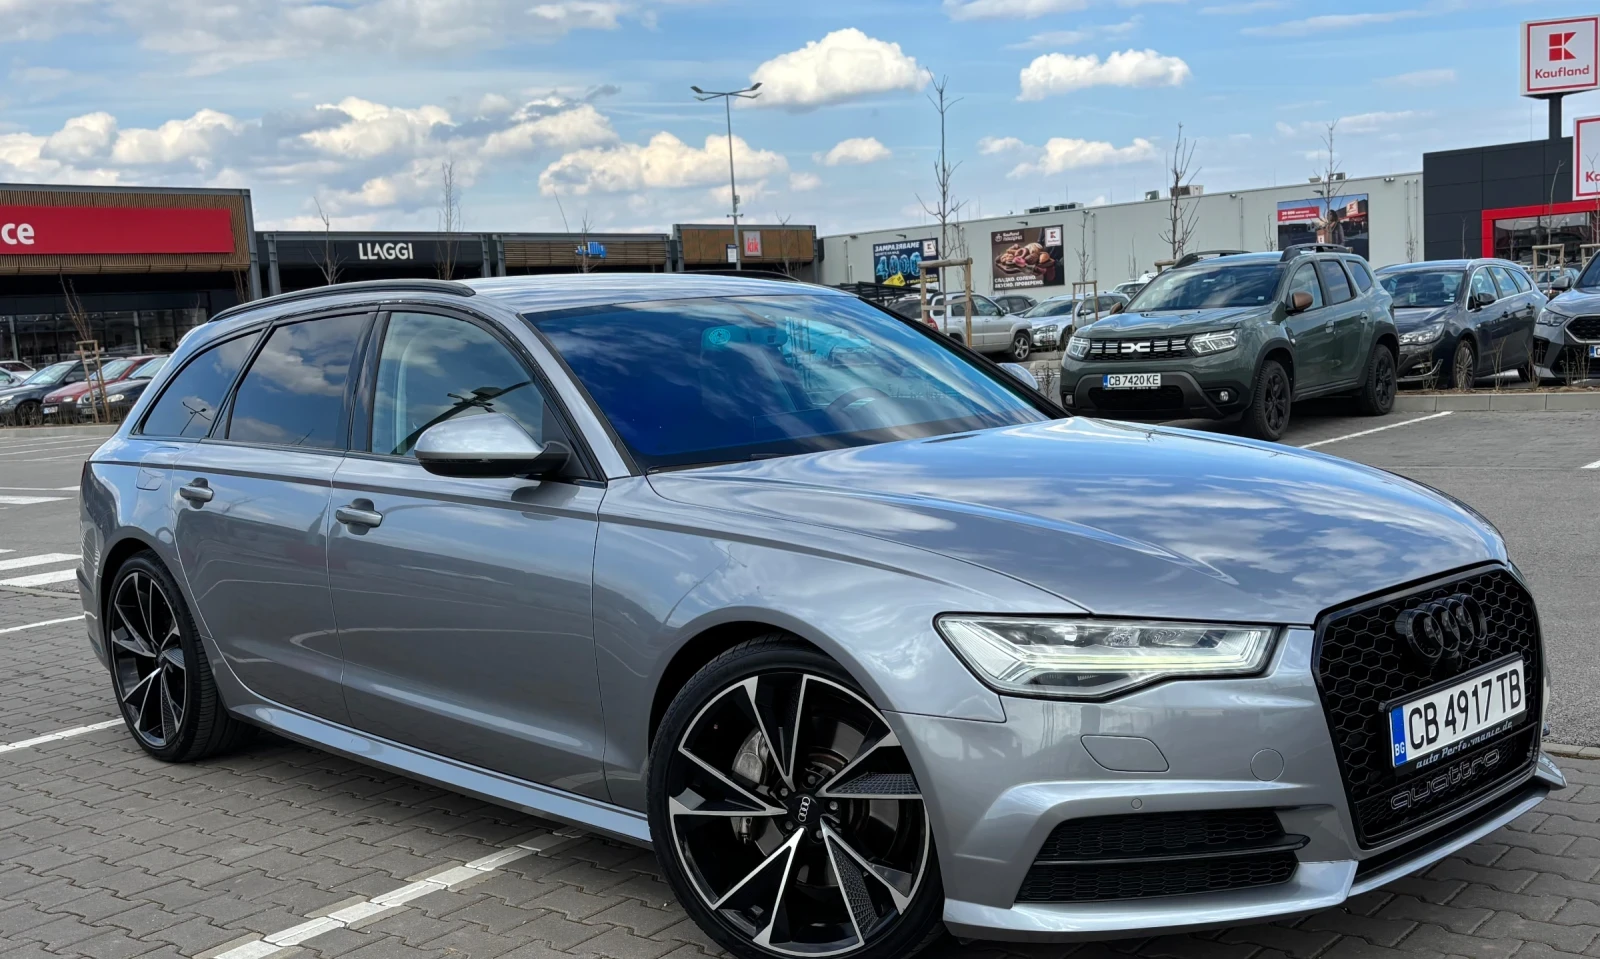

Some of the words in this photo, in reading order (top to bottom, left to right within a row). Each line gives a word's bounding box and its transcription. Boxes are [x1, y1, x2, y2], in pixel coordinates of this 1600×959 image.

[1535, 64, 1590, 79] Kaufland
[358, 242, 414, 260] LLAGGI
[875, 241, 920, 253] ЗАМРАЗЯВАМЕ
[1109, 376, 1121, 386] CB
[1122, 375, 1145, 385] 7420
[1146, 374, 1159, 385] KE
[1408, 702, 1440, 751] CB
[1444, 678, 1493, 736] 4917
[1496, 668, 1522, 714] TB
[1394, 741, 1406, 757] BG
[1415, 754, 1439, 769] auto
[1390, 748, 1500, 810] quattro
